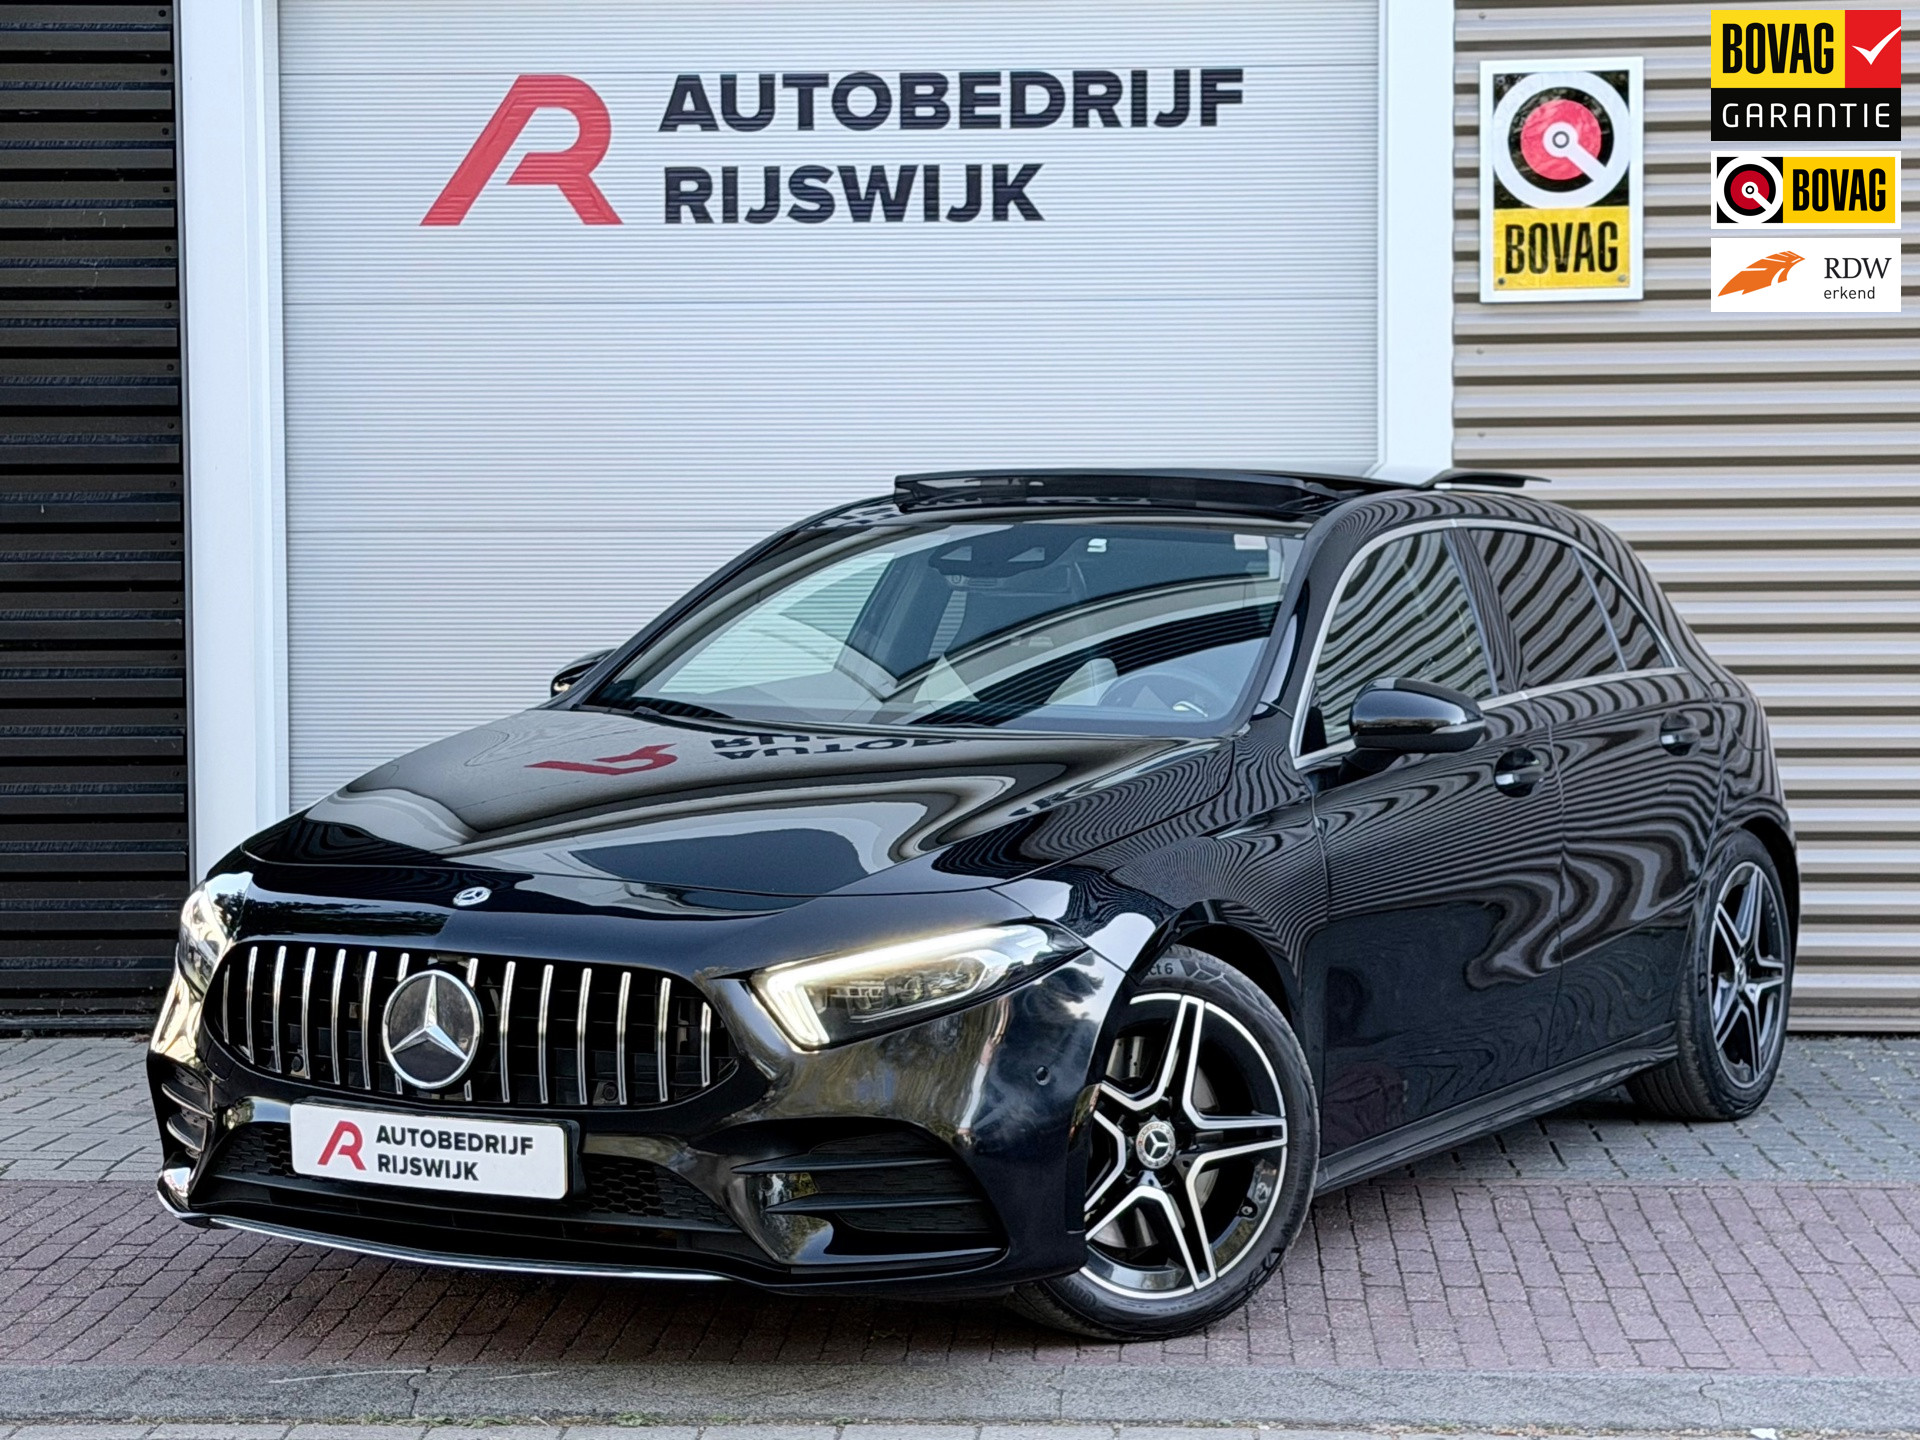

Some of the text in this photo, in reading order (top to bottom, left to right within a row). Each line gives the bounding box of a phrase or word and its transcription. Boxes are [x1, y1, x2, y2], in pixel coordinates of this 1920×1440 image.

[659, 69, 1244, 132] AUTOBEDRIJF
[664, 164, 1045, 225] RIJSWIJK
[1505, 221, 1619, 275] BOVAG
[1164, 962, 1174, 975] 6
[376, 1125, 534, 1156] AUTOBEDRIJF
[377, 1153, 480, 1181] RIJSWIJK
